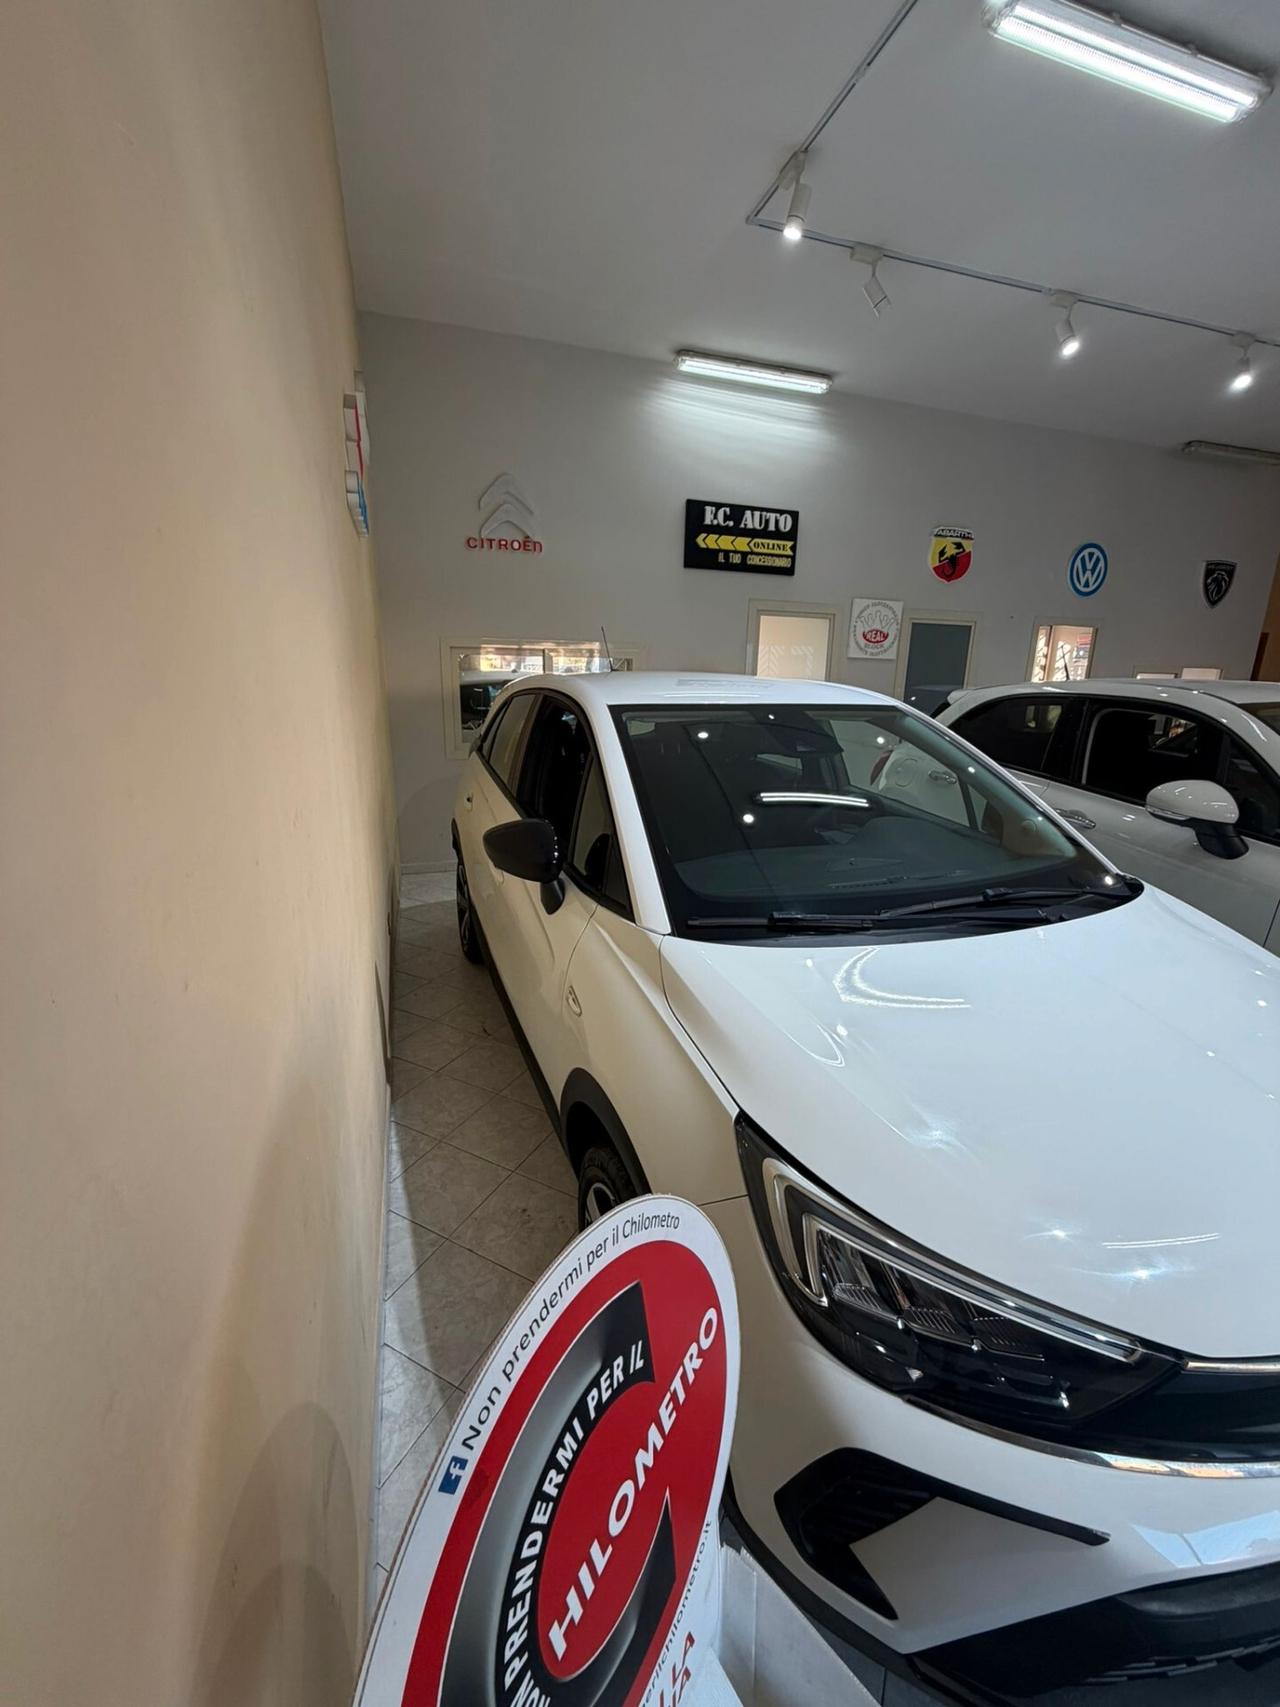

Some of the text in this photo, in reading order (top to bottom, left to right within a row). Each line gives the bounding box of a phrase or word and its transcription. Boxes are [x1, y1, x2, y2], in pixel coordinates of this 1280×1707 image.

[703, 505, 793, 532] F.C. AUTO
[753, 541, 789, 553] ONLINE
[865, 630, 886, 642] REAL
[461, 1386, 501, 1451] Non
[501, 1258, 583, 1382] prendermi
[586, 1237, 609, 1272] per
[611, 1225, 620, 1247] il
[622, 1211, 681, 1239] Chilometro
[504, 1416, 585, 1692] PRENDERMI
[586, 1361, 625, 1419] PER
[629, 1339, 645, 1378] IL
